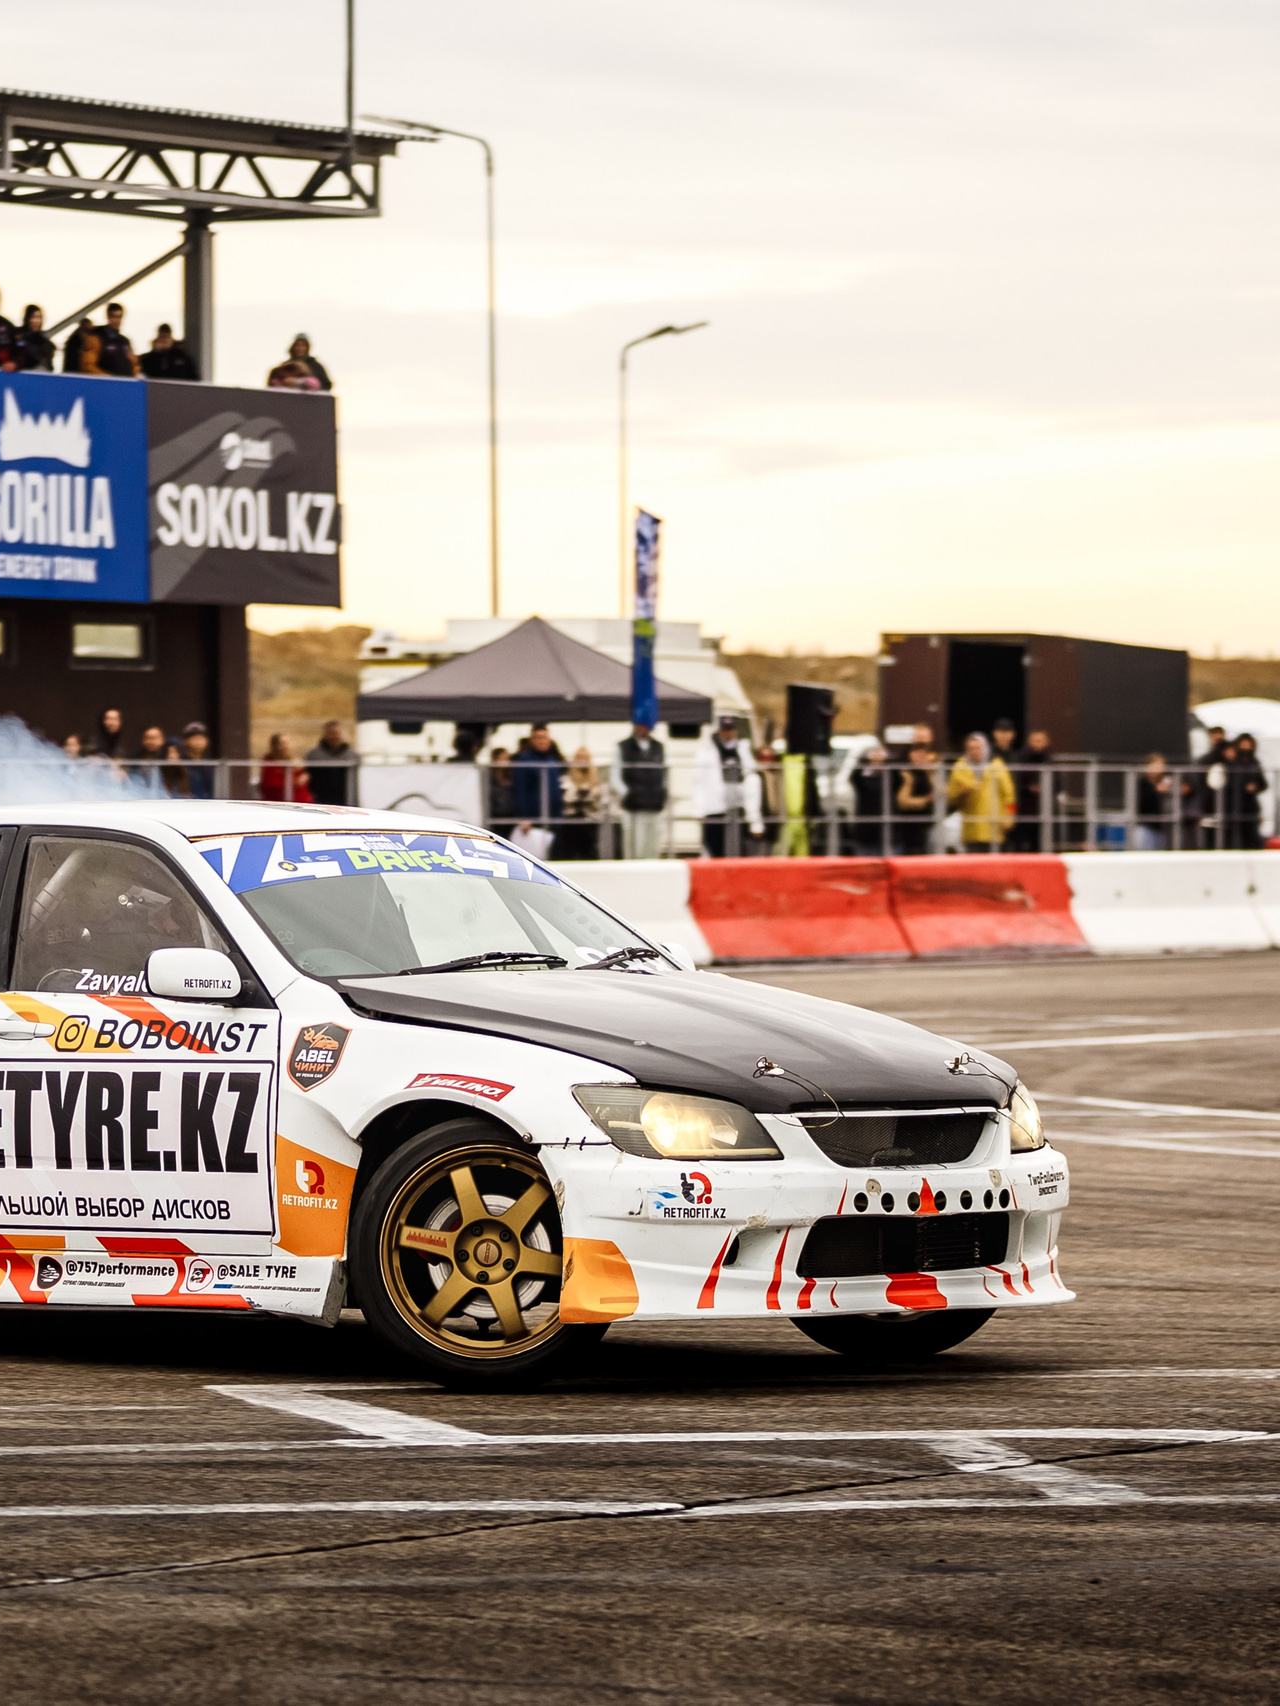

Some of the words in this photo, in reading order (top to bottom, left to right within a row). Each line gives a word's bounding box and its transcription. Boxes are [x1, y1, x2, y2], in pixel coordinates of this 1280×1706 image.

[155, 482, 338, 555] SOKOL.KZ
[53, 556, 98, 583] DRINK
[345, 849, 466, 874] DRIFT
[184, 978, 232, 989] RETROFIT.KZ
[93, 1018, 268, 1053] BOBOINST
[295, 1048, 335, 1063] ABEL
[294, 1062, 333, 1073] ЧИНИТ
[75, 1196, 145, 1218] ВЫБОР
[152, 1198, 231, 1221] ДИСКОВ
[282, 1194, 338, 1210] RETROFIT.KZ
[663, 1207, 726, 1219] RETROFIT.KZ
[66, 1260, 175, 1276] @757performance
